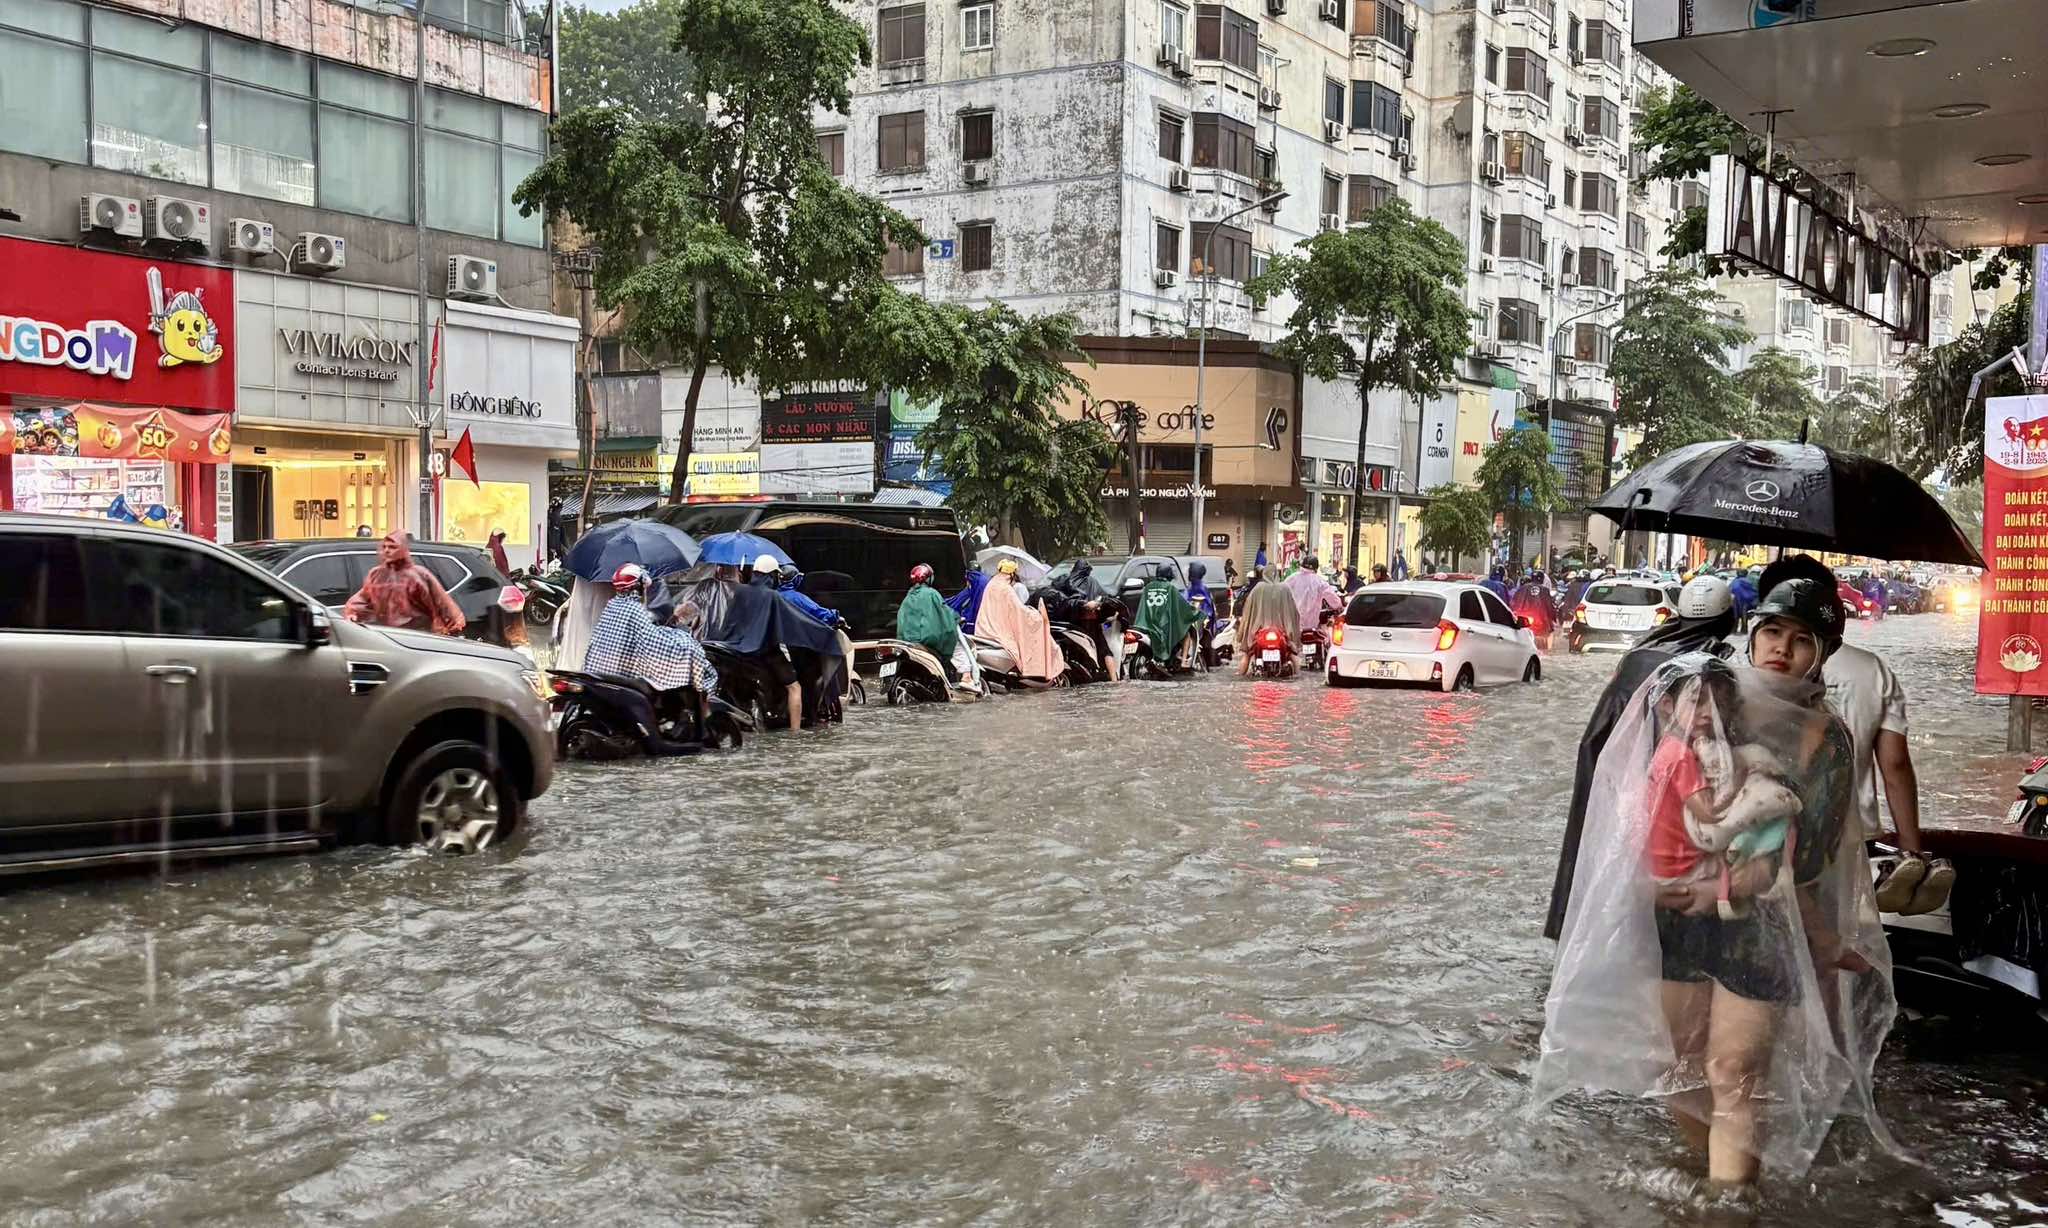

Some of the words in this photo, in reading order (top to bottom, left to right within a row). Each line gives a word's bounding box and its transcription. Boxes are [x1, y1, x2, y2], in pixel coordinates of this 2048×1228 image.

[279, 328, 412, 366] VIVIMOON
[296, 361, 338, 374] Contact
[341, 366, 367, 378] Lens
[369, 369, 400, 381] Brand
[450, 391, 496, 415] BÔNG
[498, 396, 542, 418] BIÊNG
[1714, 498, 1799, 519] Mercedes-Benz
[1996, 554, 2024, 570] THÀNH
[1995, 575, 2023, 591] THÀNH
[2003, 597, 2031, 613] THÀNH
[2033, 597, 2048, 613] CÔ
